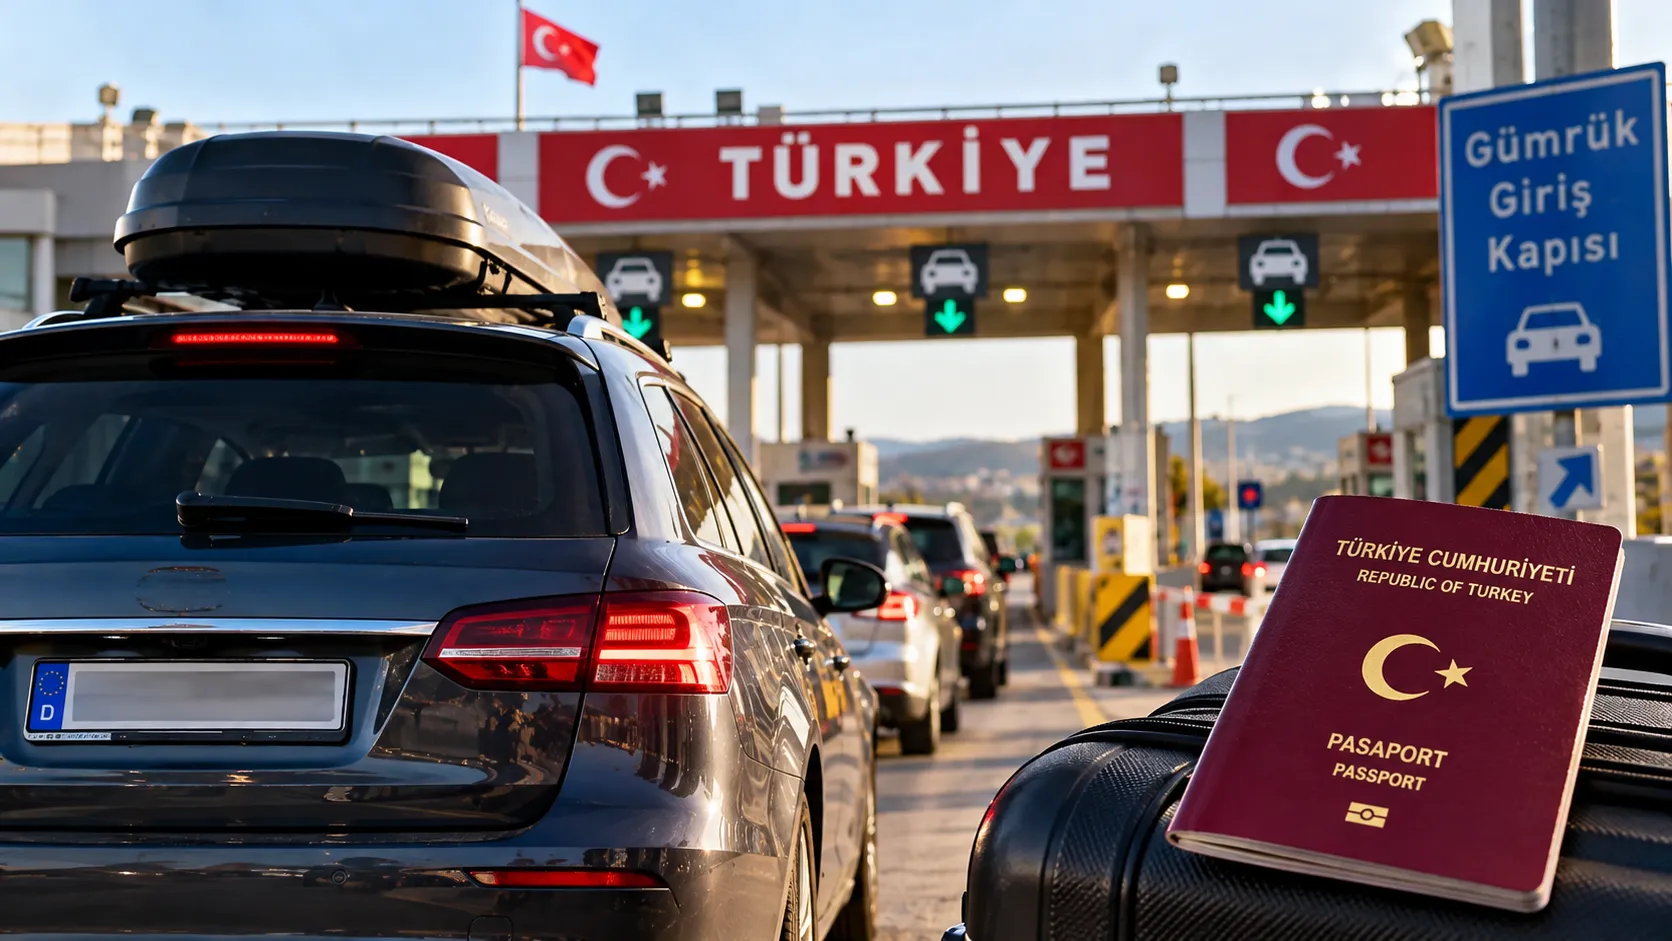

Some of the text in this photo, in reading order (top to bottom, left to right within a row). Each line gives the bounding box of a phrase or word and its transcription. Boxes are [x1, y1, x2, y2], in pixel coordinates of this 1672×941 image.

[1465, 109, 1639, 168] Gümrük
[719, 125, 1111, 200] TÜRKİYE
[1489, 172, 1592, 218] Giriş
[1487, 232, 1619, 277] Kapısı
[1336, 537, 1576, 586] TÜRKİYE CUMHURİYETİ
[1356, 569, 1534, 605] REPUBLIC OF TURKEY
[40, 704, 54, 720] D
[1327, 732, 1448, 768] PASAPORT
[1332, 762, 1427, 791] PASSPORT
